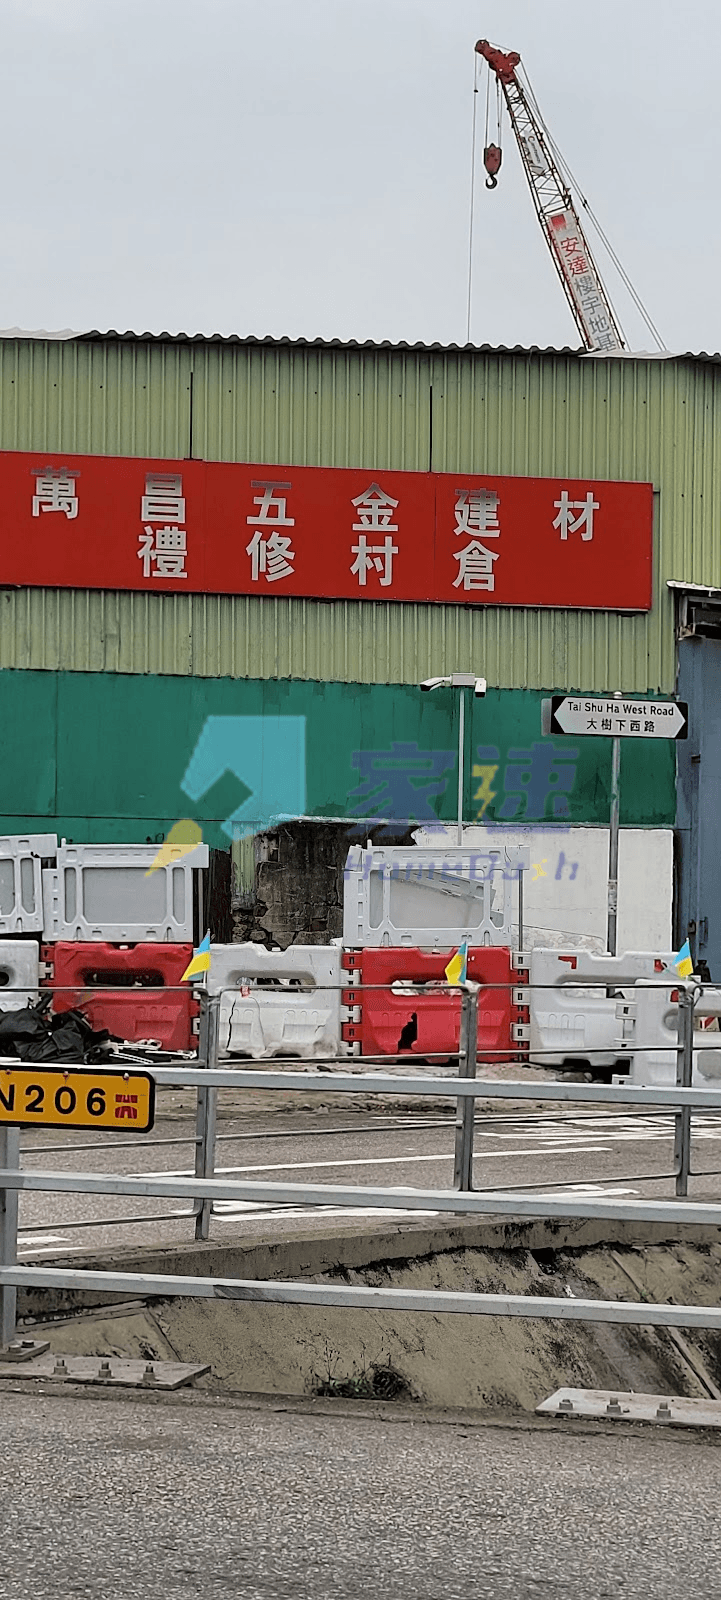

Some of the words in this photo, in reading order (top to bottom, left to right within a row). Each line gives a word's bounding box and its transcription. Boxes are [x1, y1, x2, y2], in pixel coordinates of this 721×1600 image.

[31, 466, 599, 540] 萬昌五金建材
[137, 526, 499, 591] 禮修村倉
[568, 701, 582, 712] Tai
[584, 703, 603, 713] Shu
[606, 703, 620, 714] Ha
[622, 704, 647, 715] West
[650, 706, 674, 716] Road
[586, 718, 655, 732] 大樹下西路
